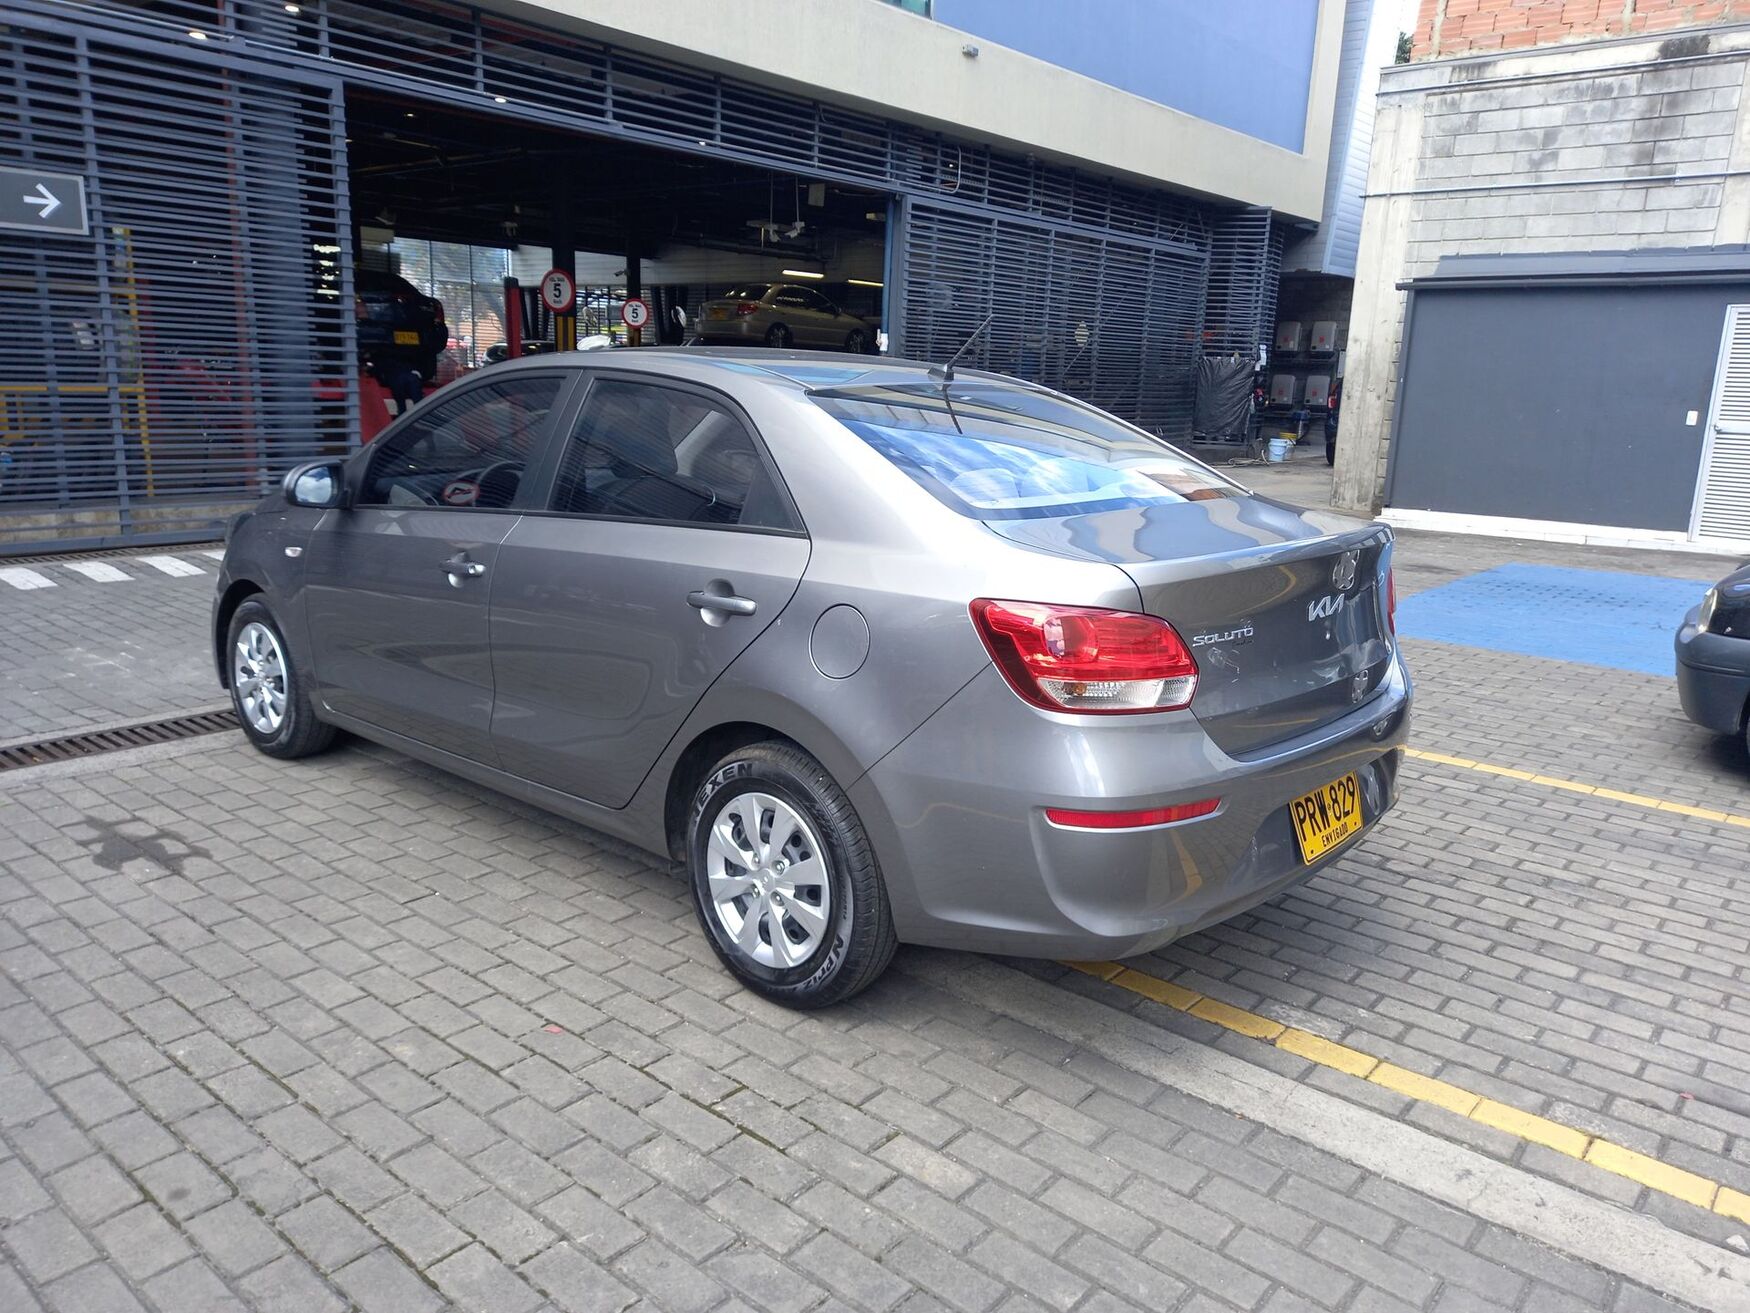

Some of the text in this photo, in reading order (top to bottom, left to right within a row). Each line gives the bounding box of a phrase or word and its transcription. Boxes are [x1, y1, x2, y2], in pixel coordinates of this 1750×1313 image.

[553, 282, 562, 299] 5
[632, 308, 639, 319] 5
[1308, 593, 1345, 622] KIA
[1192, 627, 1254, 647] SOLUTO
[1321, 822, 1349, 847] ENVIGADO
